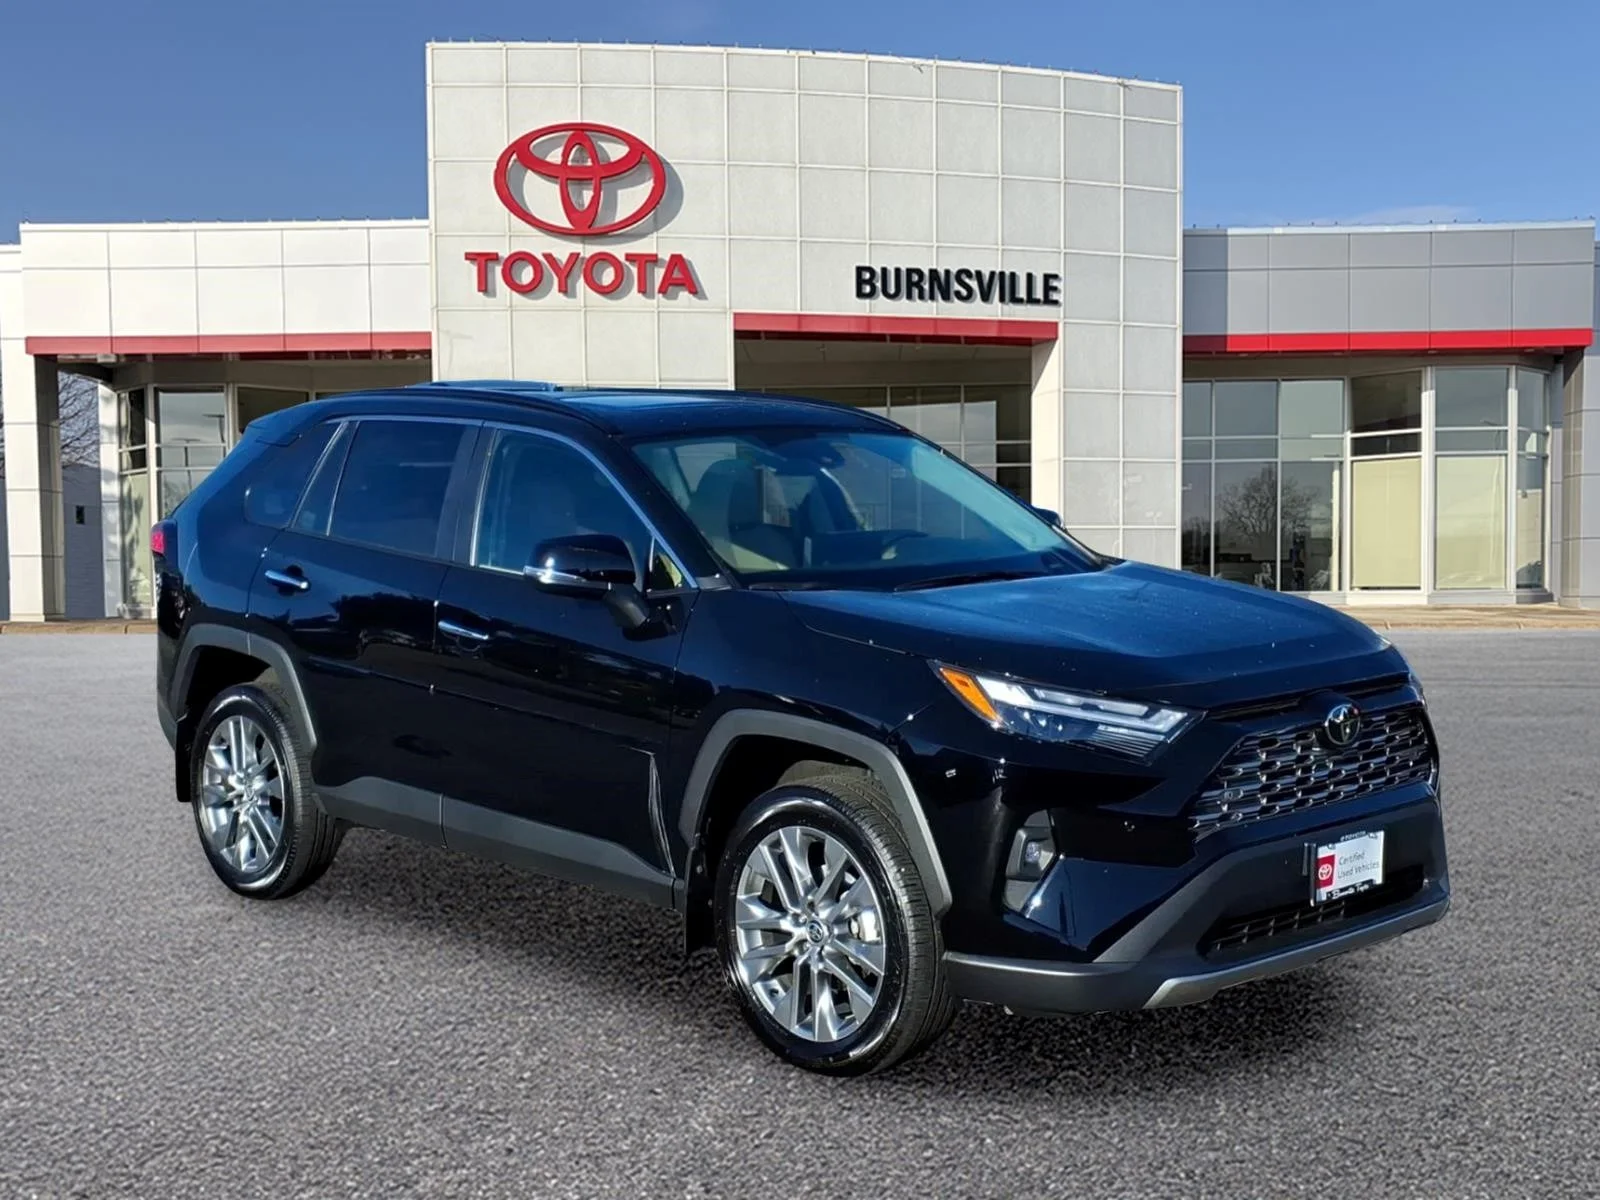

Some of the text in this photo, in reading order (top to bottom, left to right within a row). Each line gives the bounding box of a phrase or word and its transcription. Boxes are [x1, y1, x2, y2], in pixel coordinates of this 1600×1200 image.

[465, 251, 699, 295] TOYOTA
[855, 266, 1061, 304] BURNSVILLE
[1337, 861, 1380, 879] Used Vehicles
[1339, 851, 1365, 866] Certified
